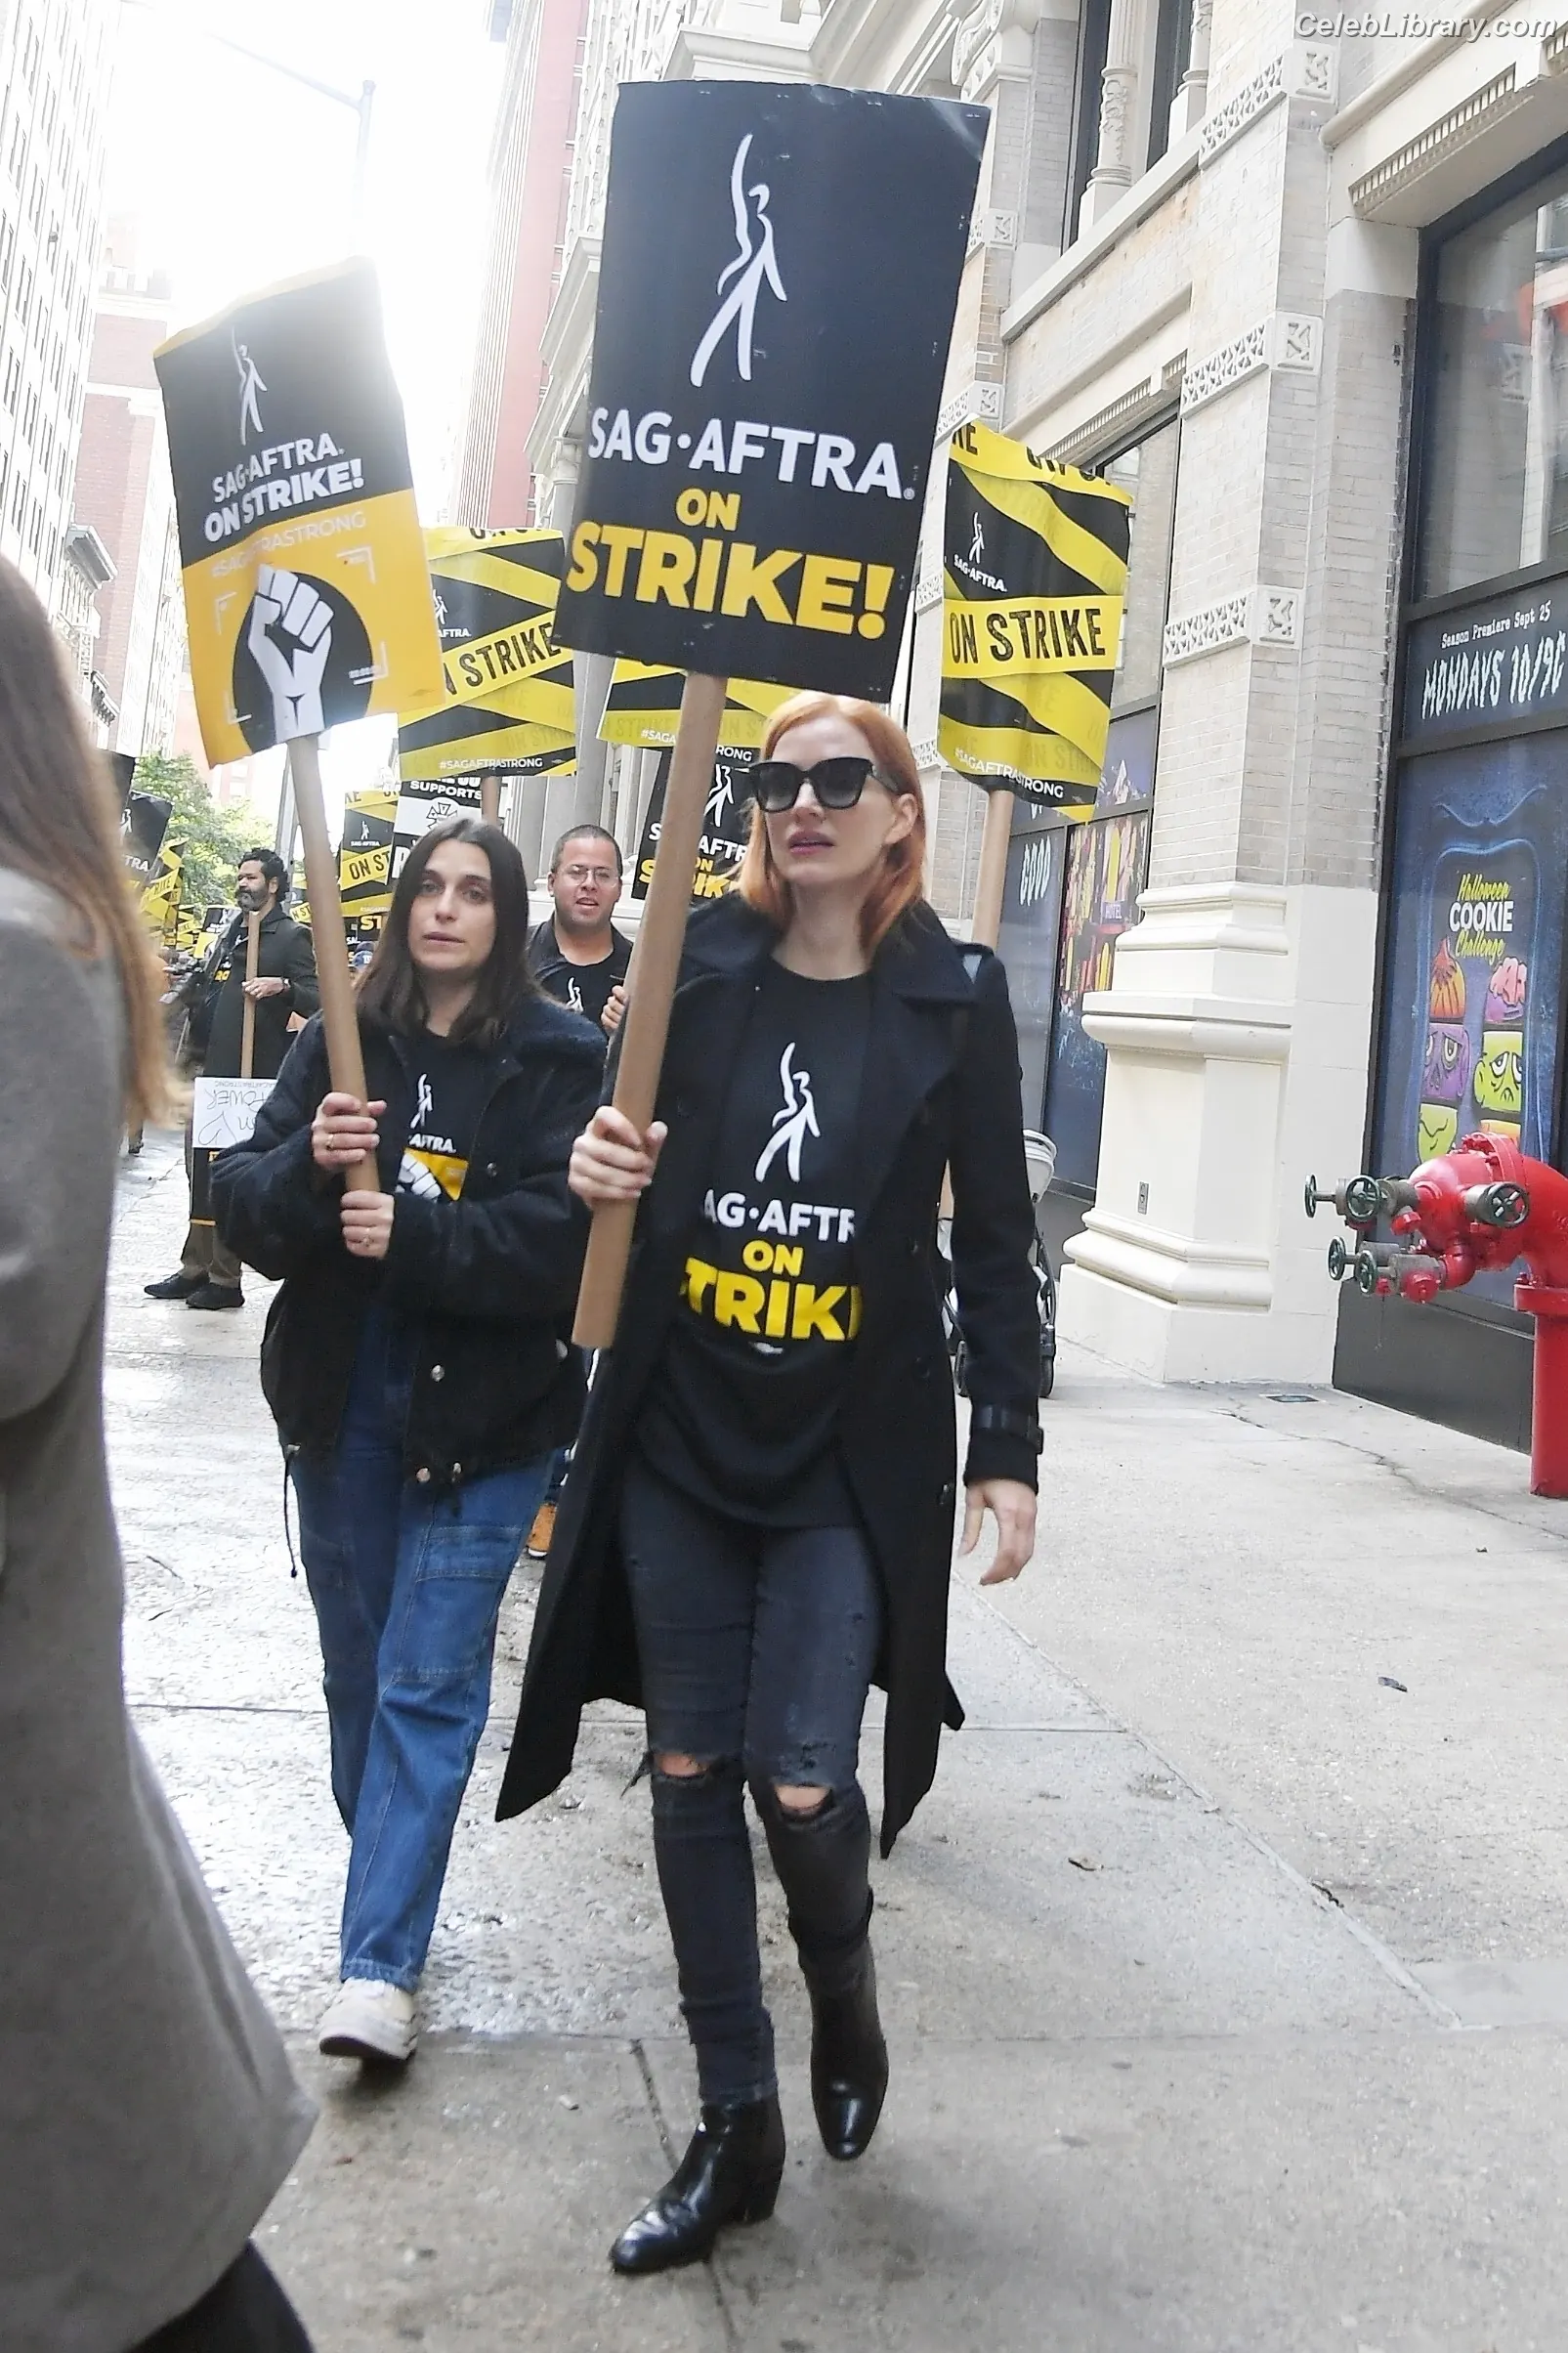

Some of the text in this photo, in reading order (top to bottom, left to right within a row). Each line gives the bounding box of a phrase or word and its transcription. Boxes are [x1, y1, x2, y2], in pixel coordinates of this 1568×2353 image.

[204, 458, 364, 542] ON STRIKE!
[675, 489, 742, 532] ON
[566, 521, 895, 640] STRIKE!
[950, 608, 1107, 664] ON STRIKE
[1441, 599, 1551, 649] Season Premiere Sept 25
[459, 621, 562, 687] STRIKE
[1421, 630, 1566, 719] MONDAYS 10/9C
[440, 758, 543, 771] #SAGAFTRASTRONG
[954, 747, 1064, 799] #SAGAFTRASTRONG
[410, 780, 483, 800] SUPPORTS
[349, 859, 370, 879] ON
[1457, 873, 1510, 902] Halloween
[1449, 900, 1513, 932] COOKIE
[1455, 929, 1504, 966] Challenge
[204, 1089, 268, 1113] POWER
[742, 1239, 804, 1277] ON
[679, 1257, 863, 1342] TRIK
